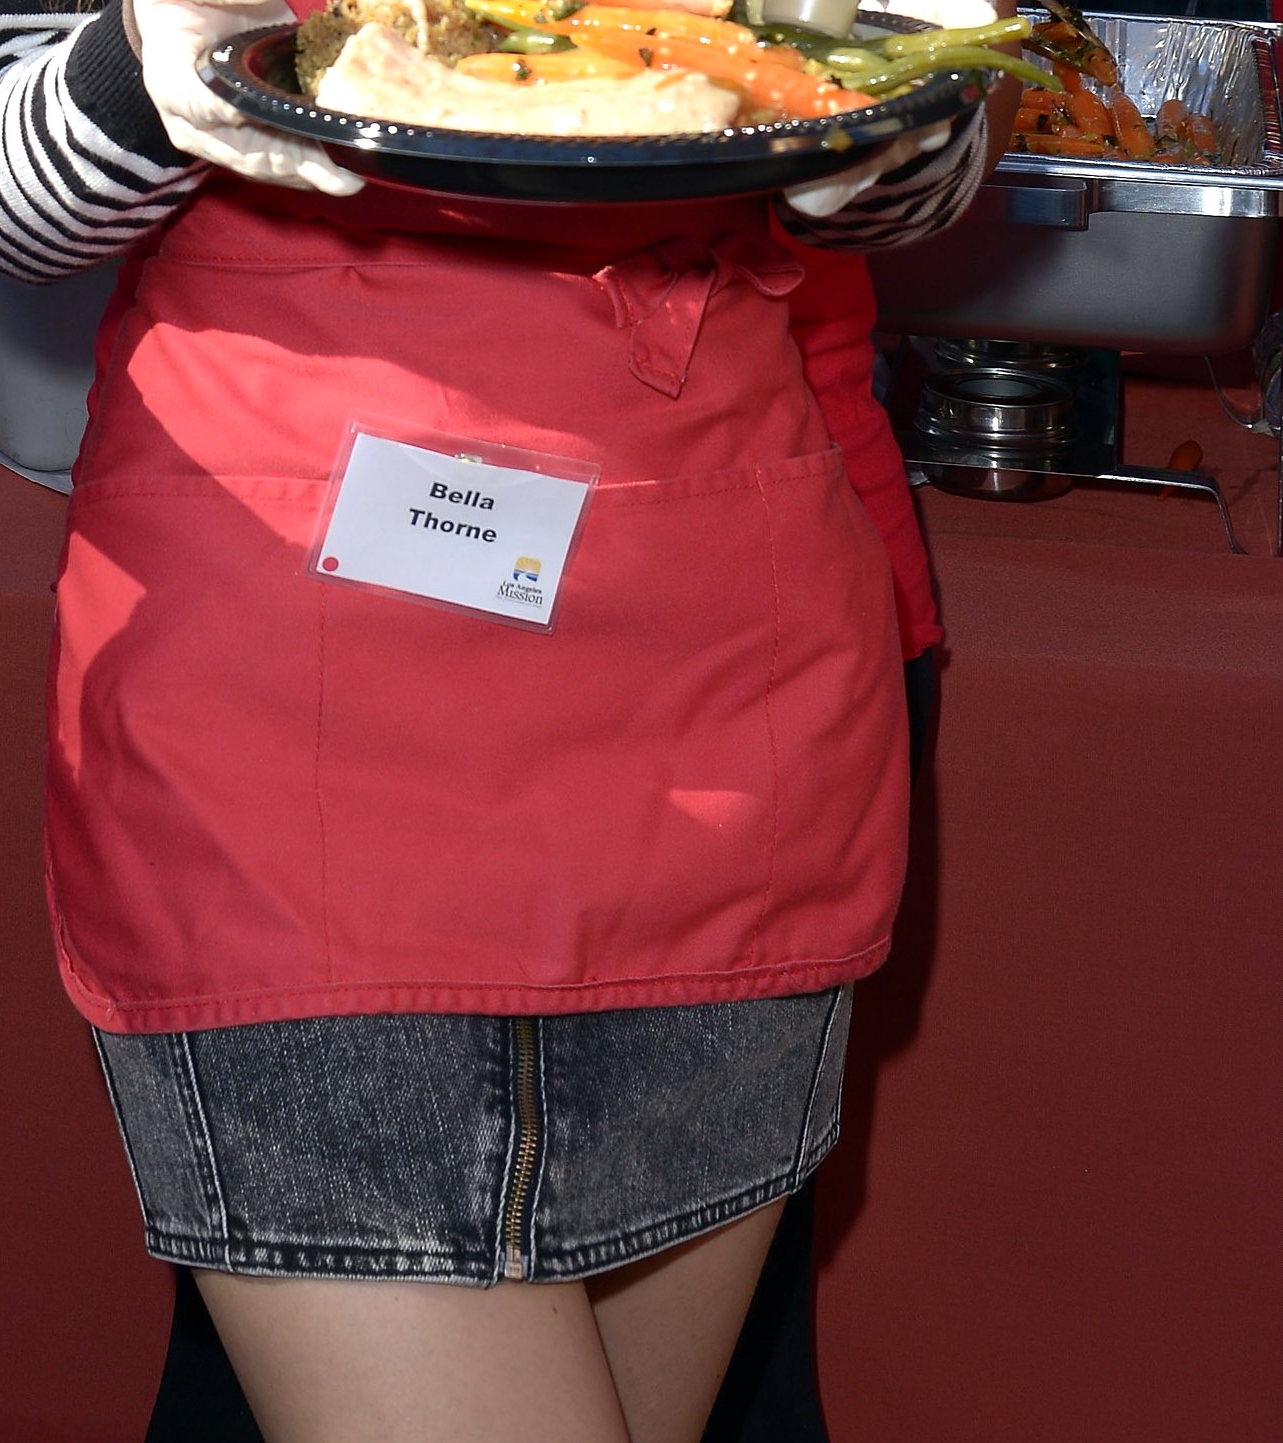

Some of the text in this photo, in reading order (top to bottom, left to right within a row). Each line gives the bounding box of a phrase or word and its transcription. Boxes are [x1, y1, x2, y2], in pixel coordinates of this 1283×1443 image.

[429, 481, 495, 510] Bella
[409, 509, 498, 543] Thorne
[497, 584, 544, 605] Mission
